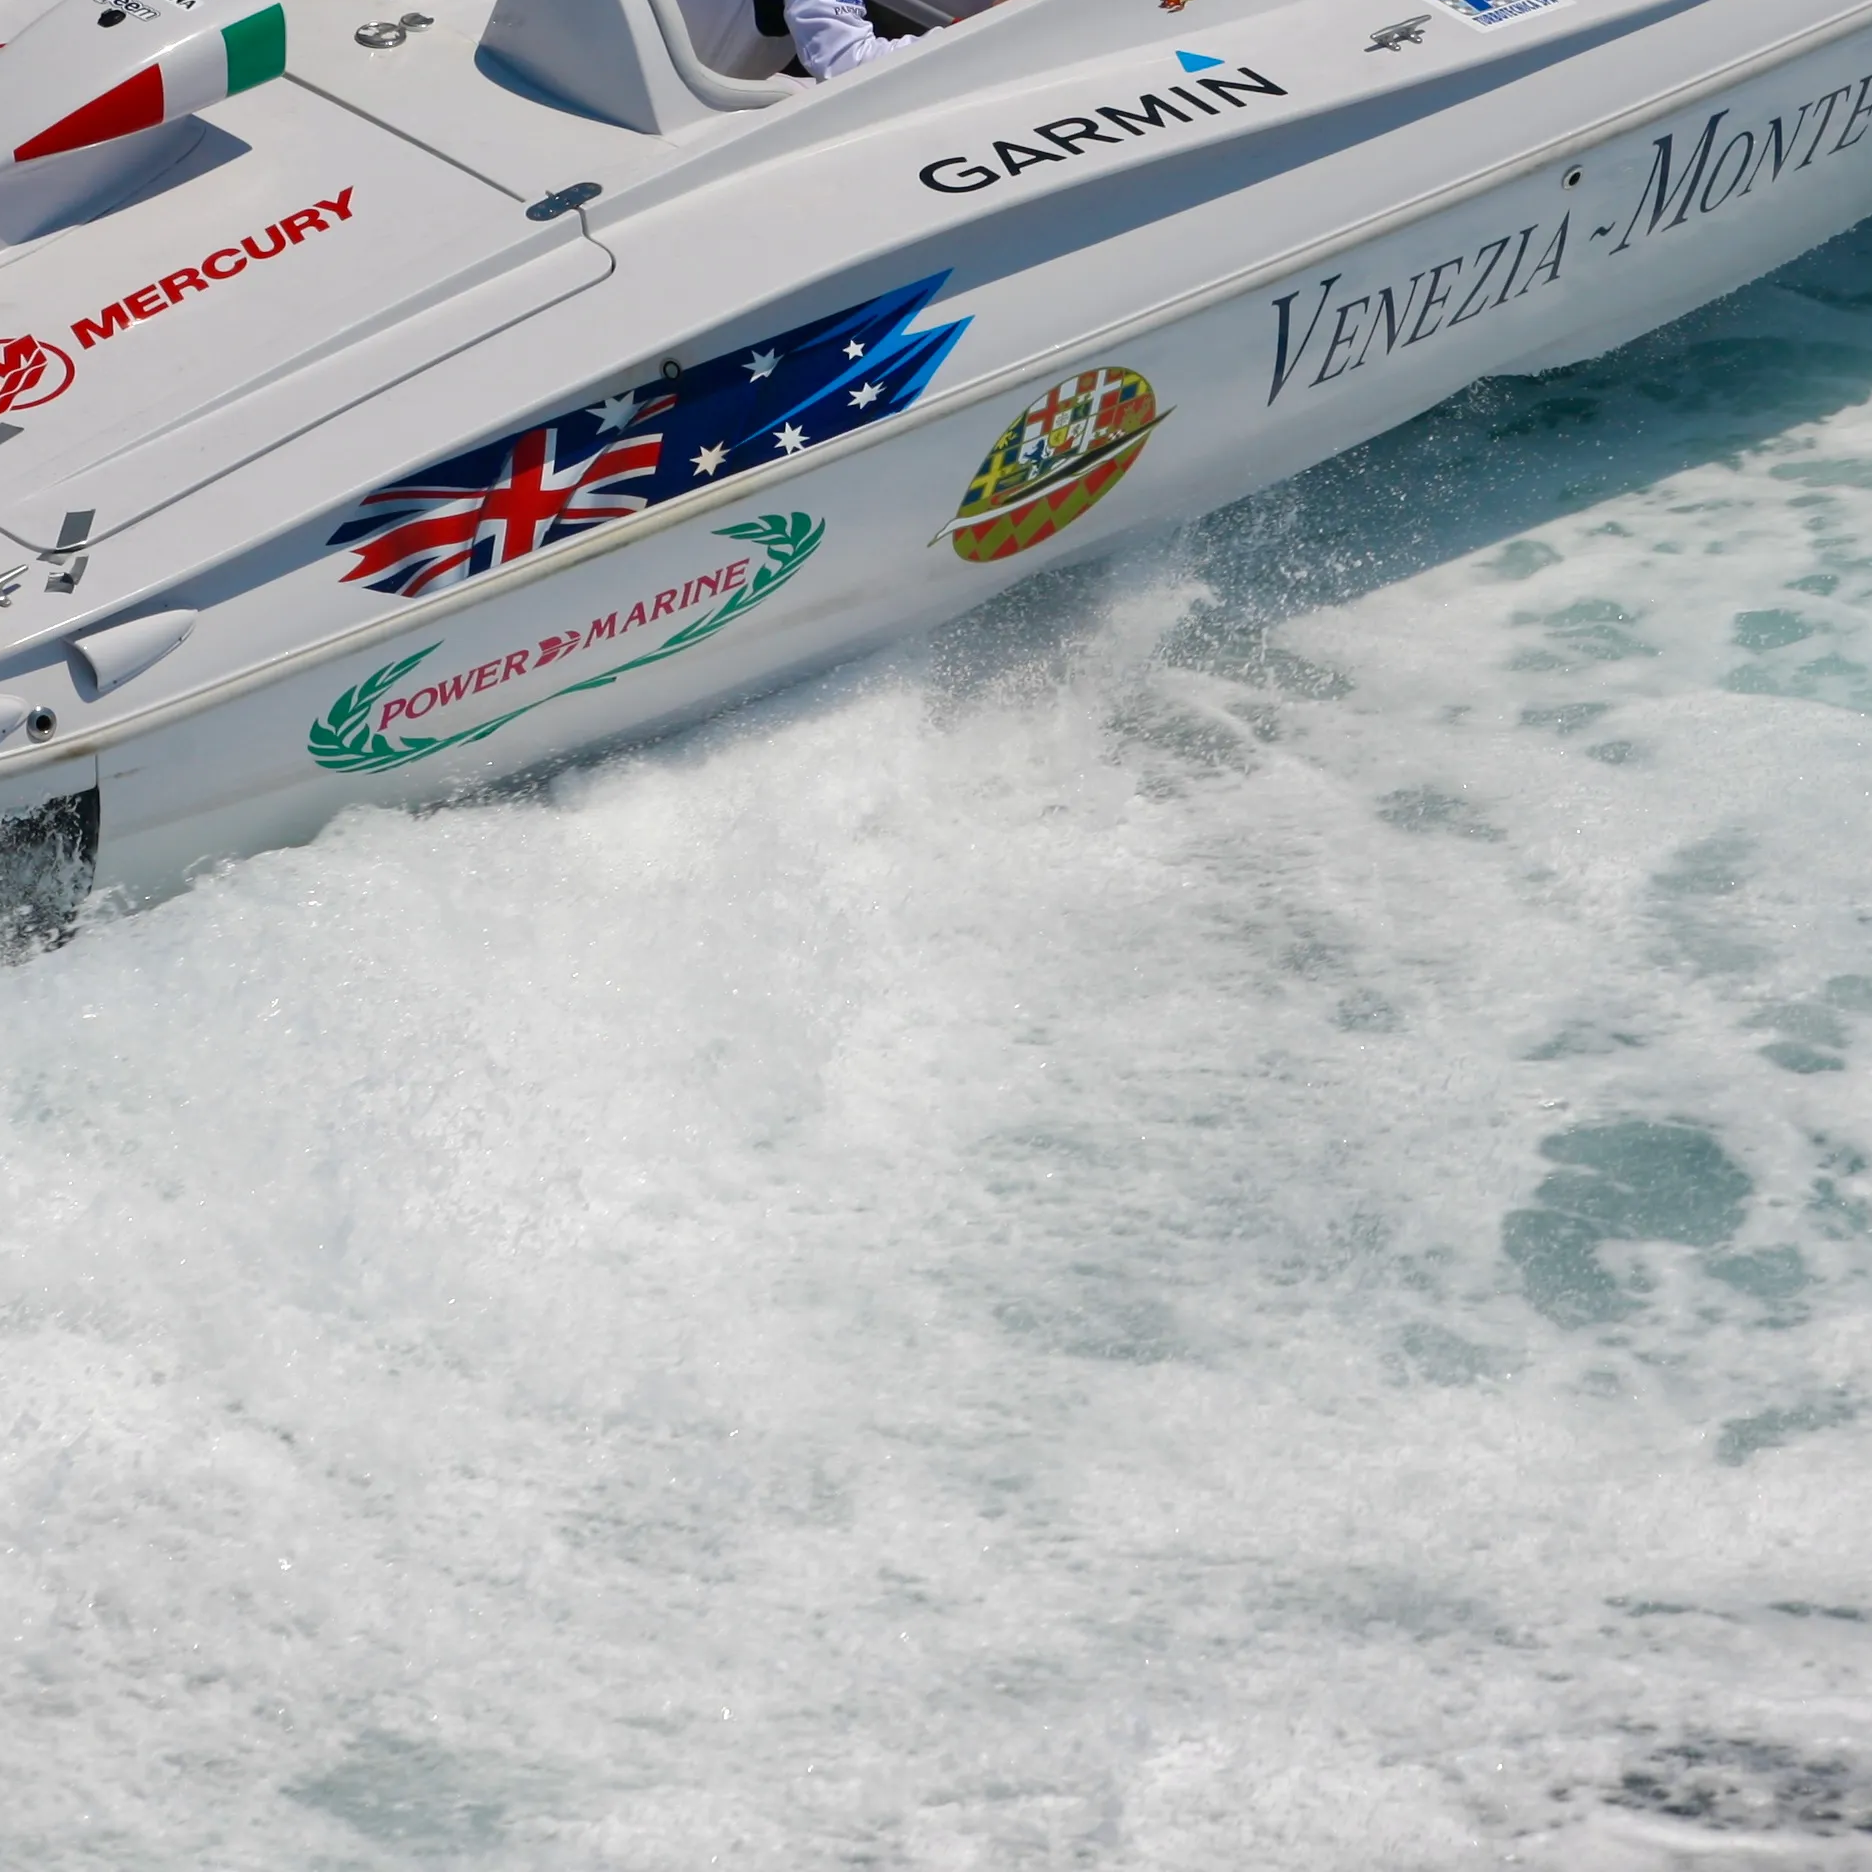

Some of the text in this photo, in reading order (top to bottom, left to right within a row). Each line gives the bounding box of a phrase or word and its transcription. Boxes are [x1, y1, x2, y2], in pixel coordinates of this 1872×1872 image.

[919, 66, 1288, 193] GARMIN
[69, 185, 354, 350] MERCURY
[1266, 208, 1573, 407] VENEZIA
[376, 557, 751, 732] POWER MARINE
